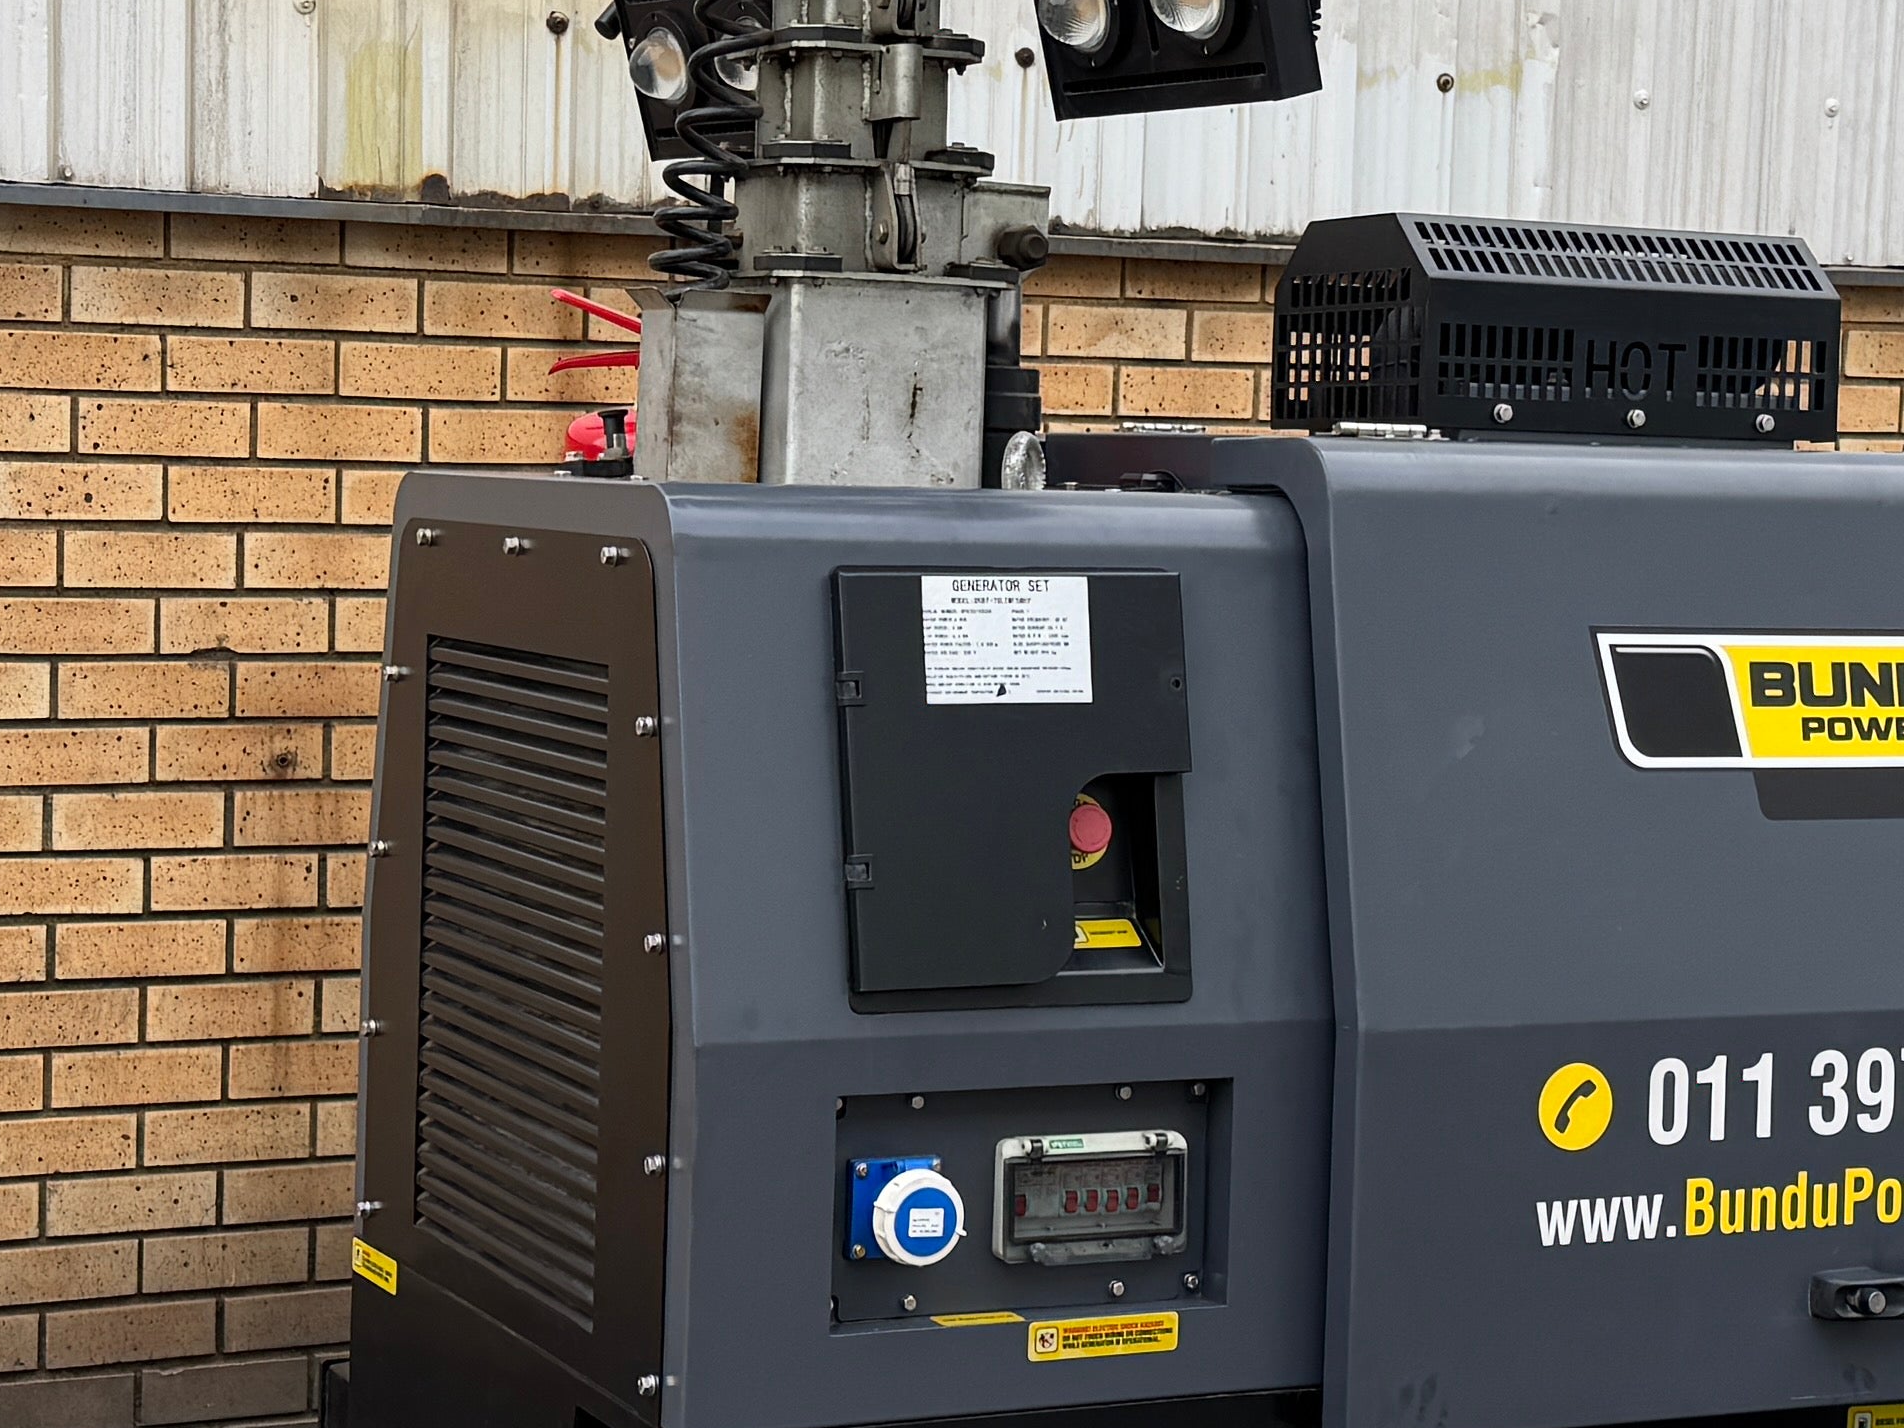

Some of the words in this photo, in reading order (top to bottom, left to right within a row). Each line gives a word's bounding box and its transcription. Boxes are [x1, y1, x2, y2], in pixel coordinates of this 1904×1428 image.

[1584, 339, 1687, 402] HOT
[952, 579, 1021, 593] GENERATOR
[1028, 579, 1050, 593] SET
[1648, 1052, 1775, 1147] 011
